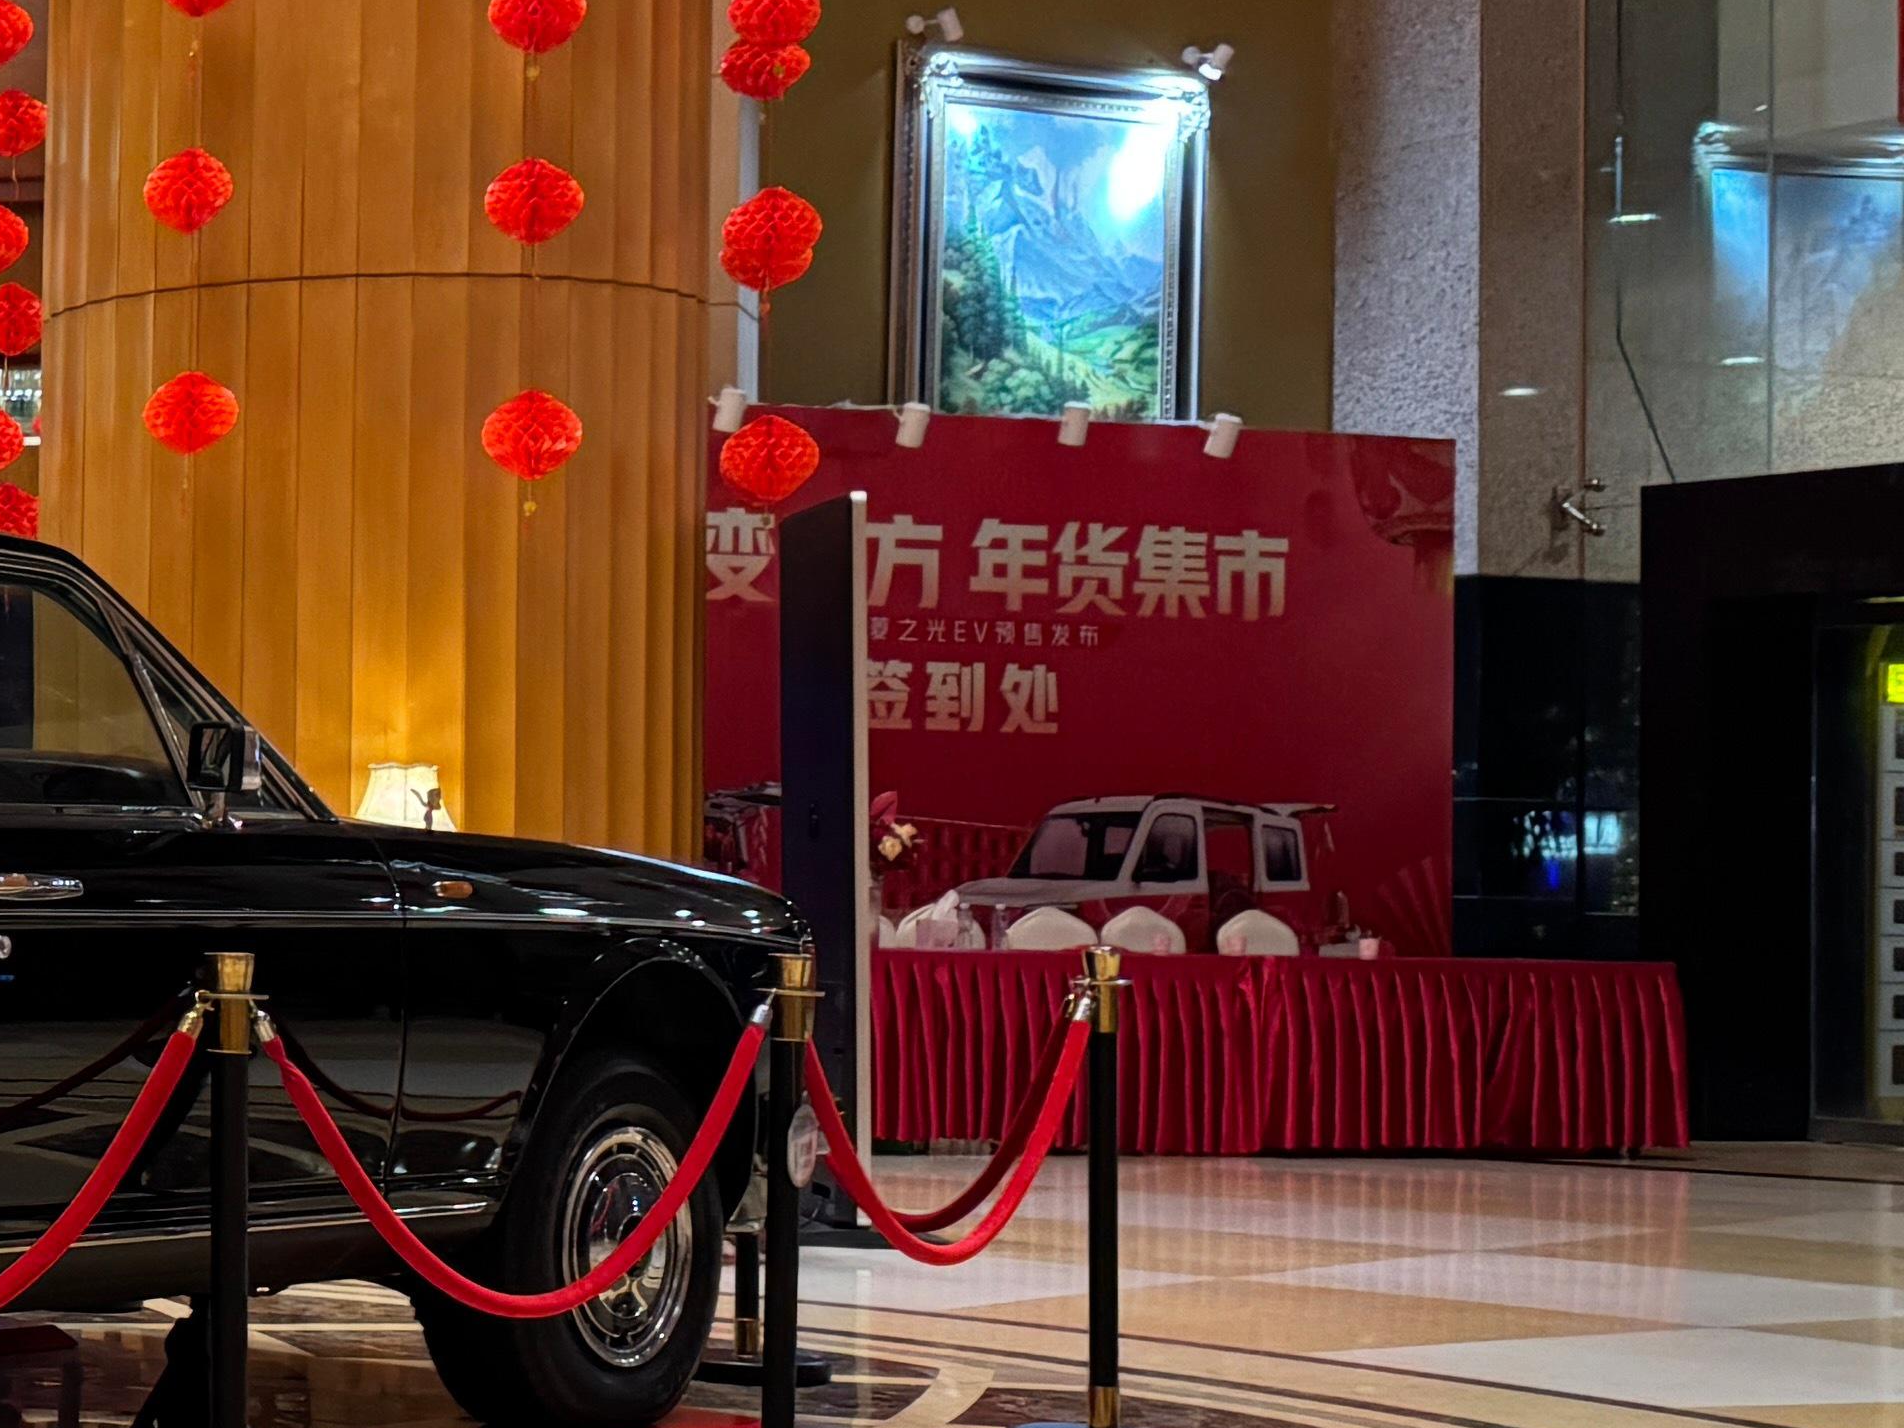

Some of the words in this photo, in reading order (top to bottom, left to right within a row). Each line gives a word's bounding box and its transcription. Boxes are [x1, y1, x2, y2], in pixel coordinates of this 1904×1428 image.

[969, 518, 1290, 622] 年货集市
[867, 659, 1059, 734] 签到处
